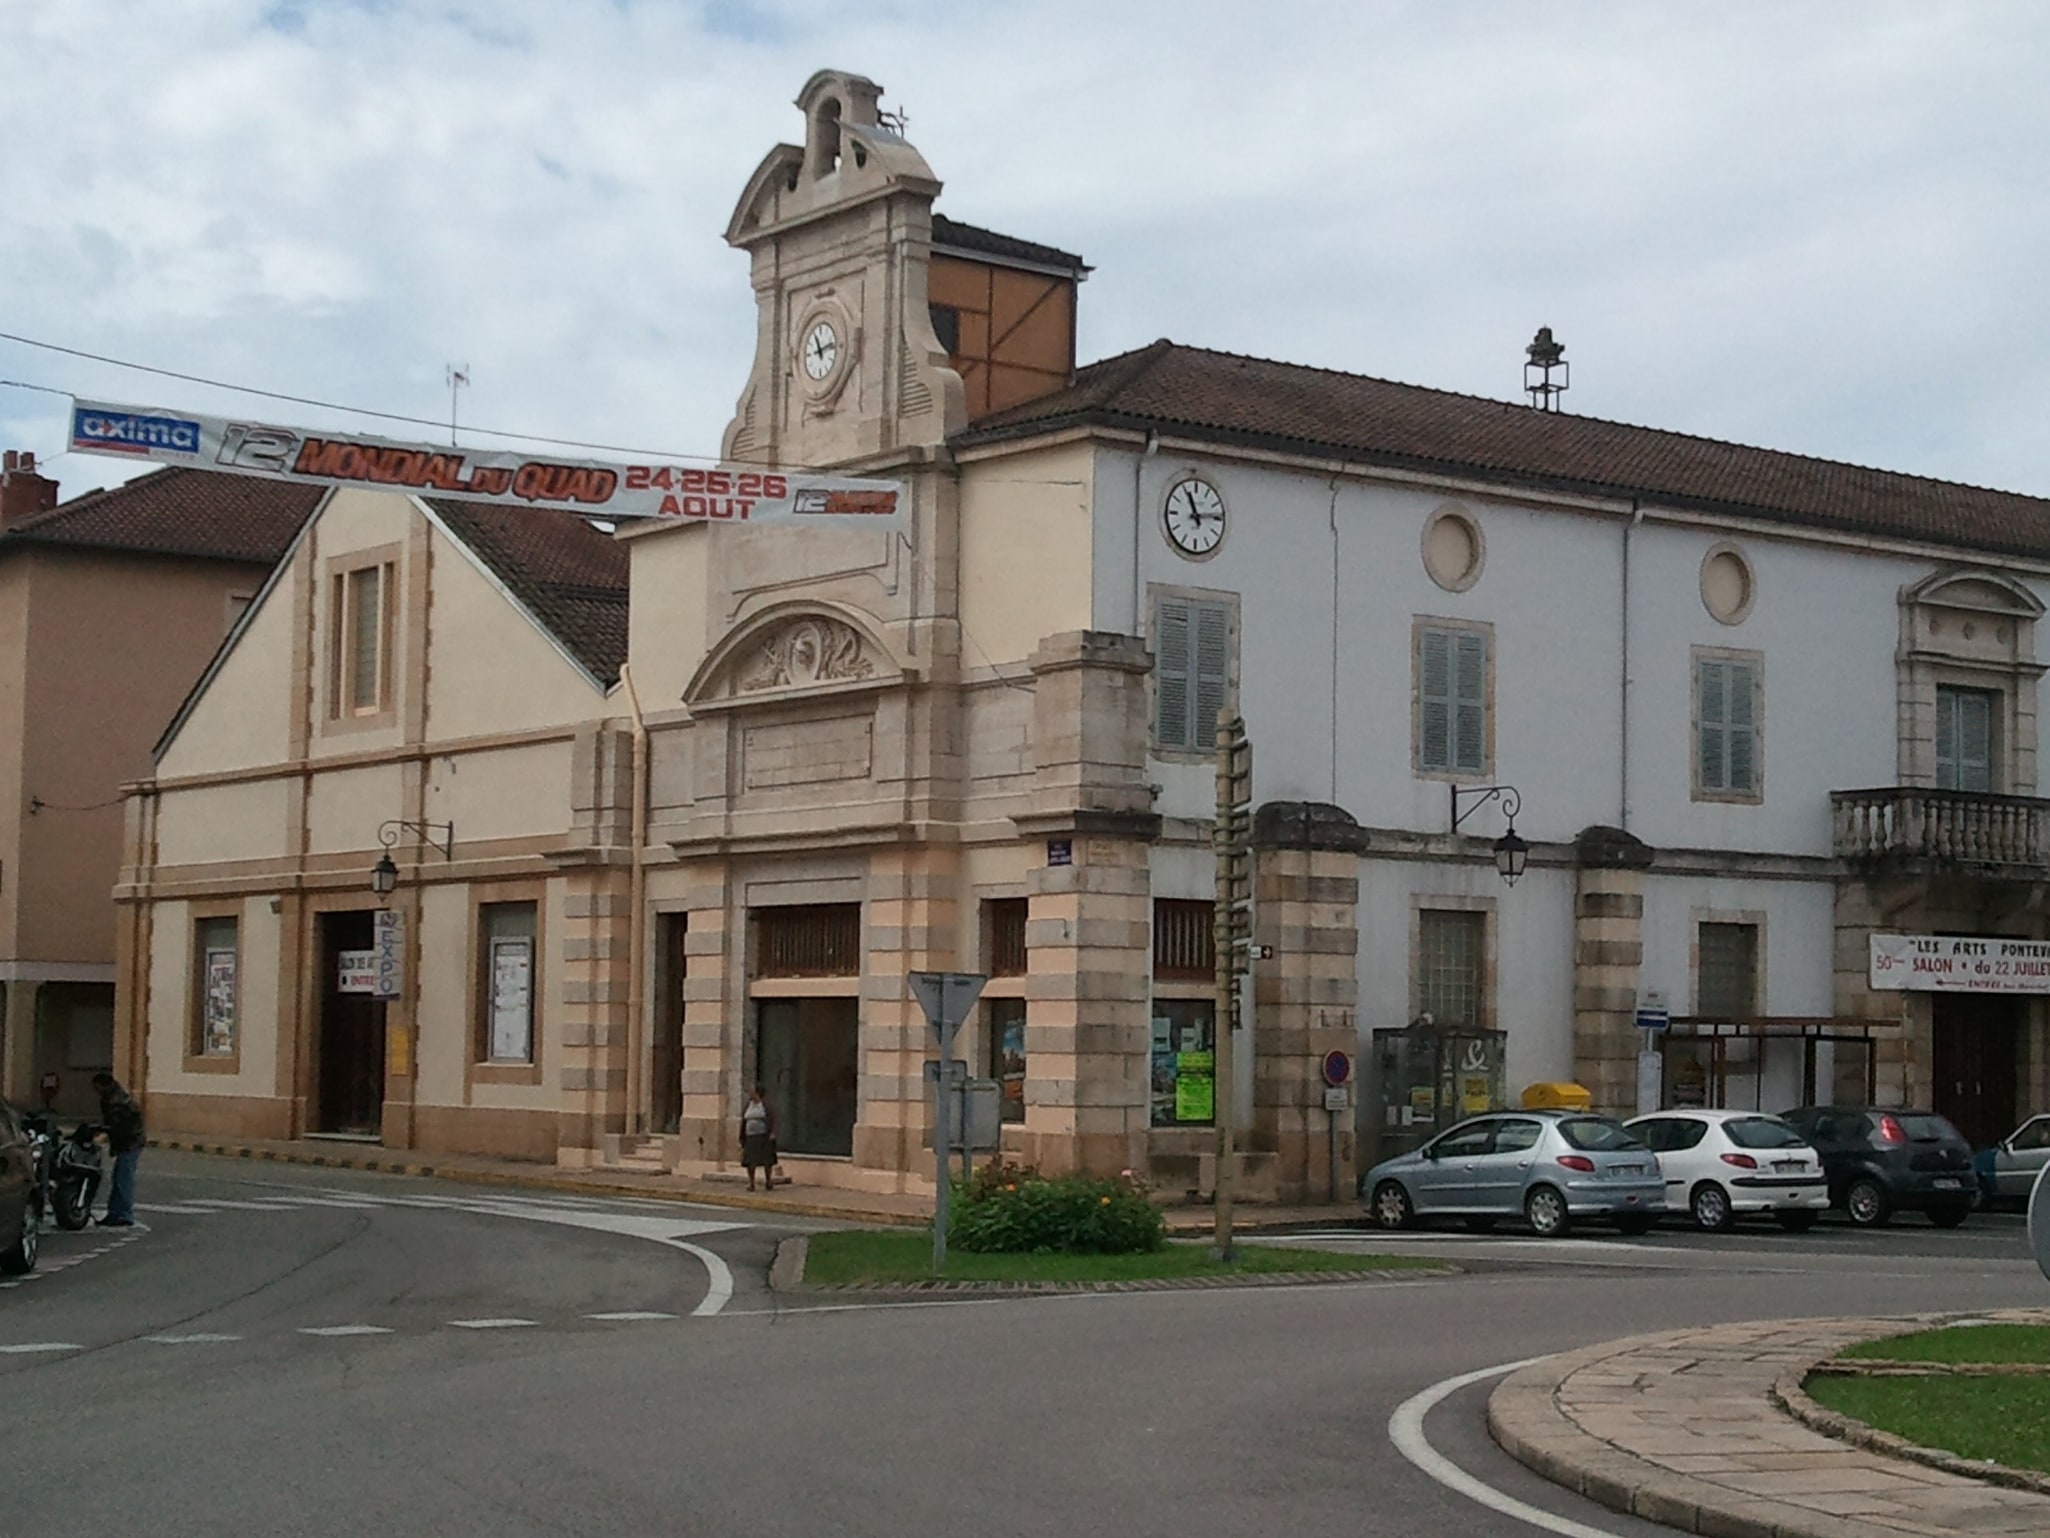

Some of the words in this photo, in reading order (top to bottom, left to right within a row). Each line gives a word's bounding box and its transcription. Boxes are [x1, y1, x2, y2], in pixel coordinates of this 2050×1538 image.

[82, 414, 194, 448] axima
[215, 423, 299, 472] 12
[292, 437, 467, 490] MONDIAL
[471, 466, 514, 495] DU
[512, 462, 618, 504] QUAD
[658, 494, 756, 520] AOUT
[1953, 942, 1986, 956] ARTS
[1912, 957, 1953, 974] SALON
[1975, 960, 1991, 975] du
[1995, 960, 2009, 976] 22
